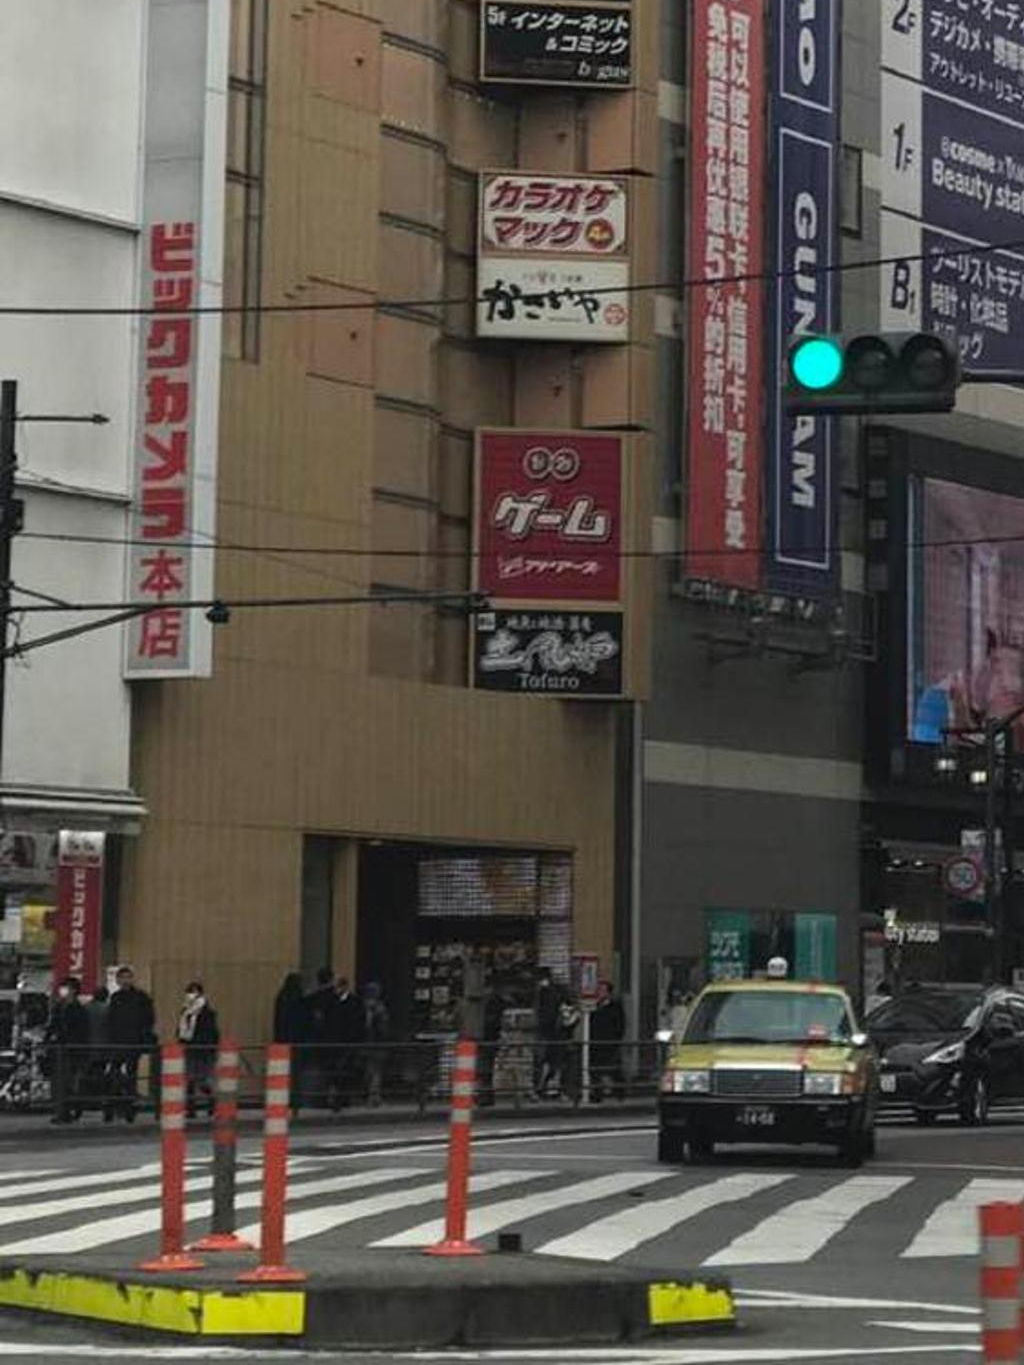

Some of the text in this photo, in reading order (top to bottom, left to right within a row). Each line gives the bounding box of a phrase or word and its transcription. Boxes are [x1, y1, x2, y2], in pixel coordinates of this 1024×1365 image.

[510, 11, 630, 35] インターネット
[893, 122, 914, 172] 1F
[489, 180, 615, 216] カラオケ
[931, 157, 995, 210] Beauty
[492, 215, 585, 249] マック
[792, 191, 818, 508] GUNAM
[493, 491, 608, 539] ゲーム
